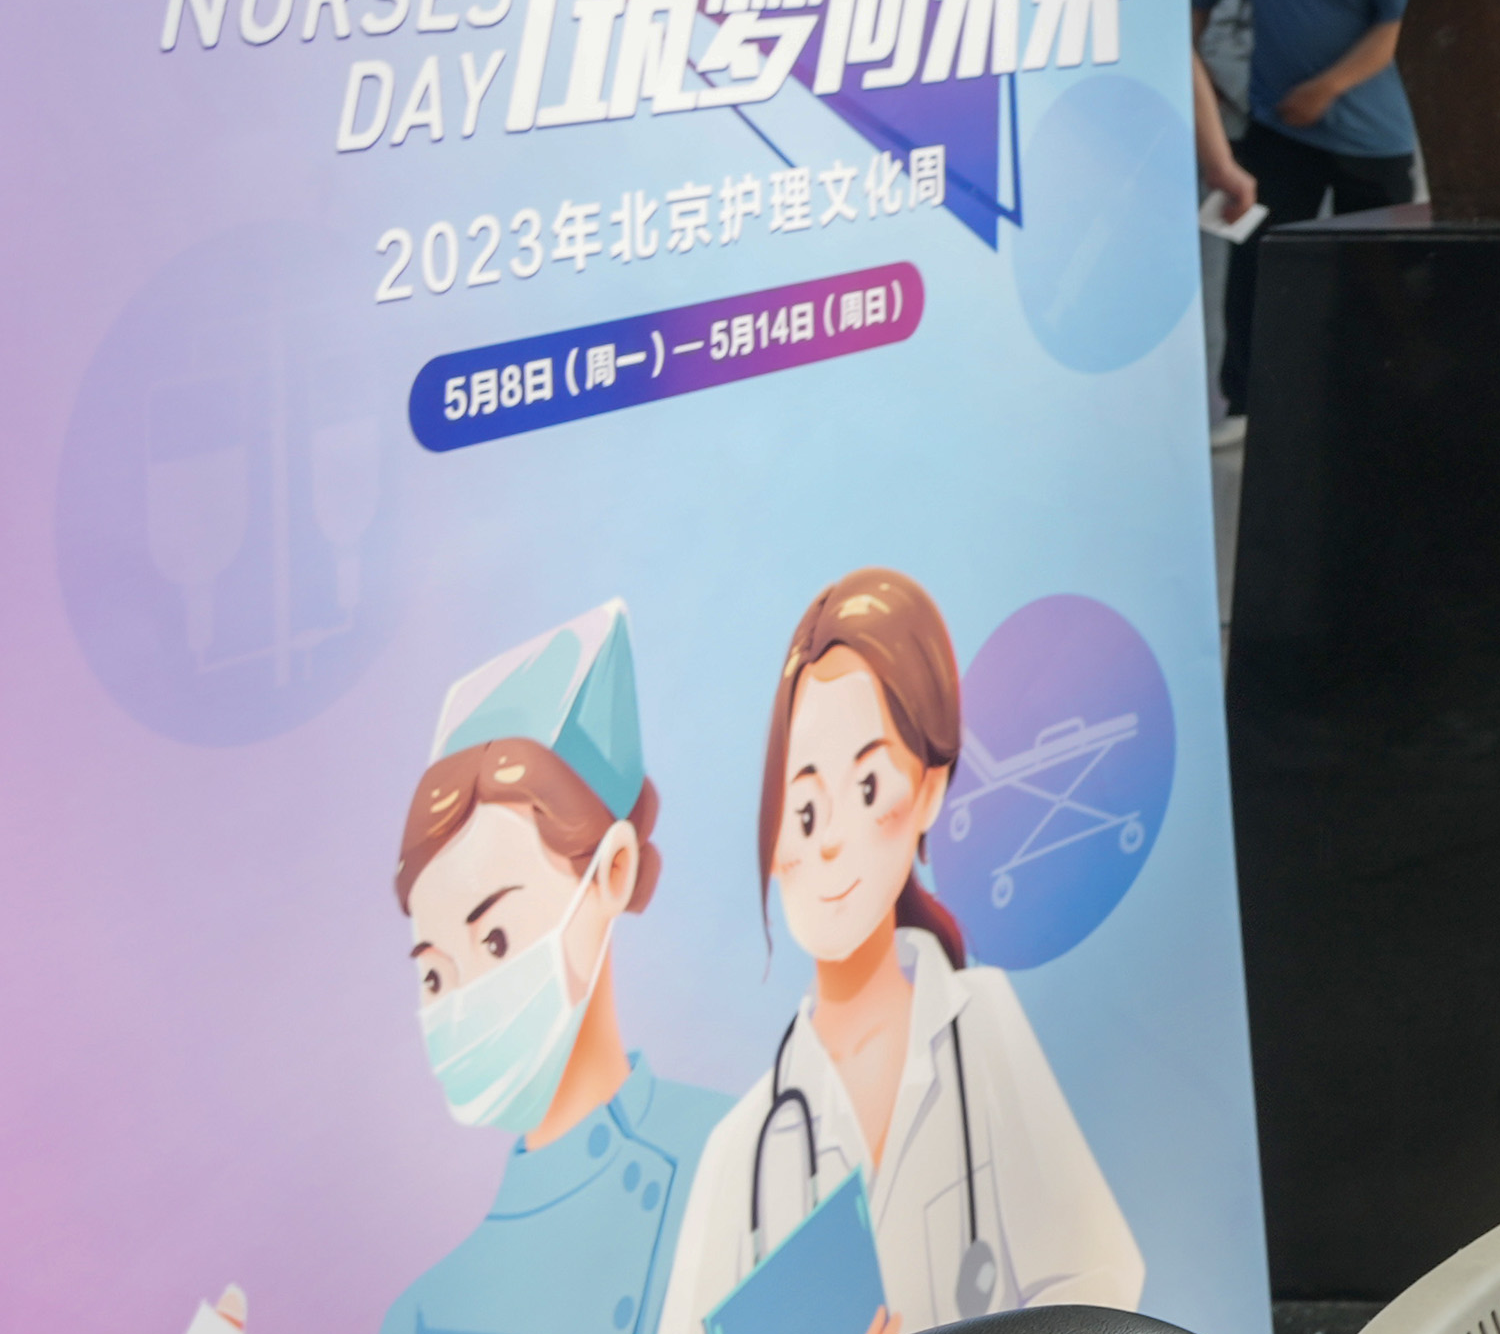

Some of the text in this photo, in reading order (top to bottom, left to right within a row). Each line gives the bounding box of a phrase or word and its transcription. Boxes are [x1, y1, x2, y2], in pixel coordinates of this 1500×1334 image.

[335, 50, 507, 153] DAY
[374, 144, 948, 305] 2023年北京护理文化周
